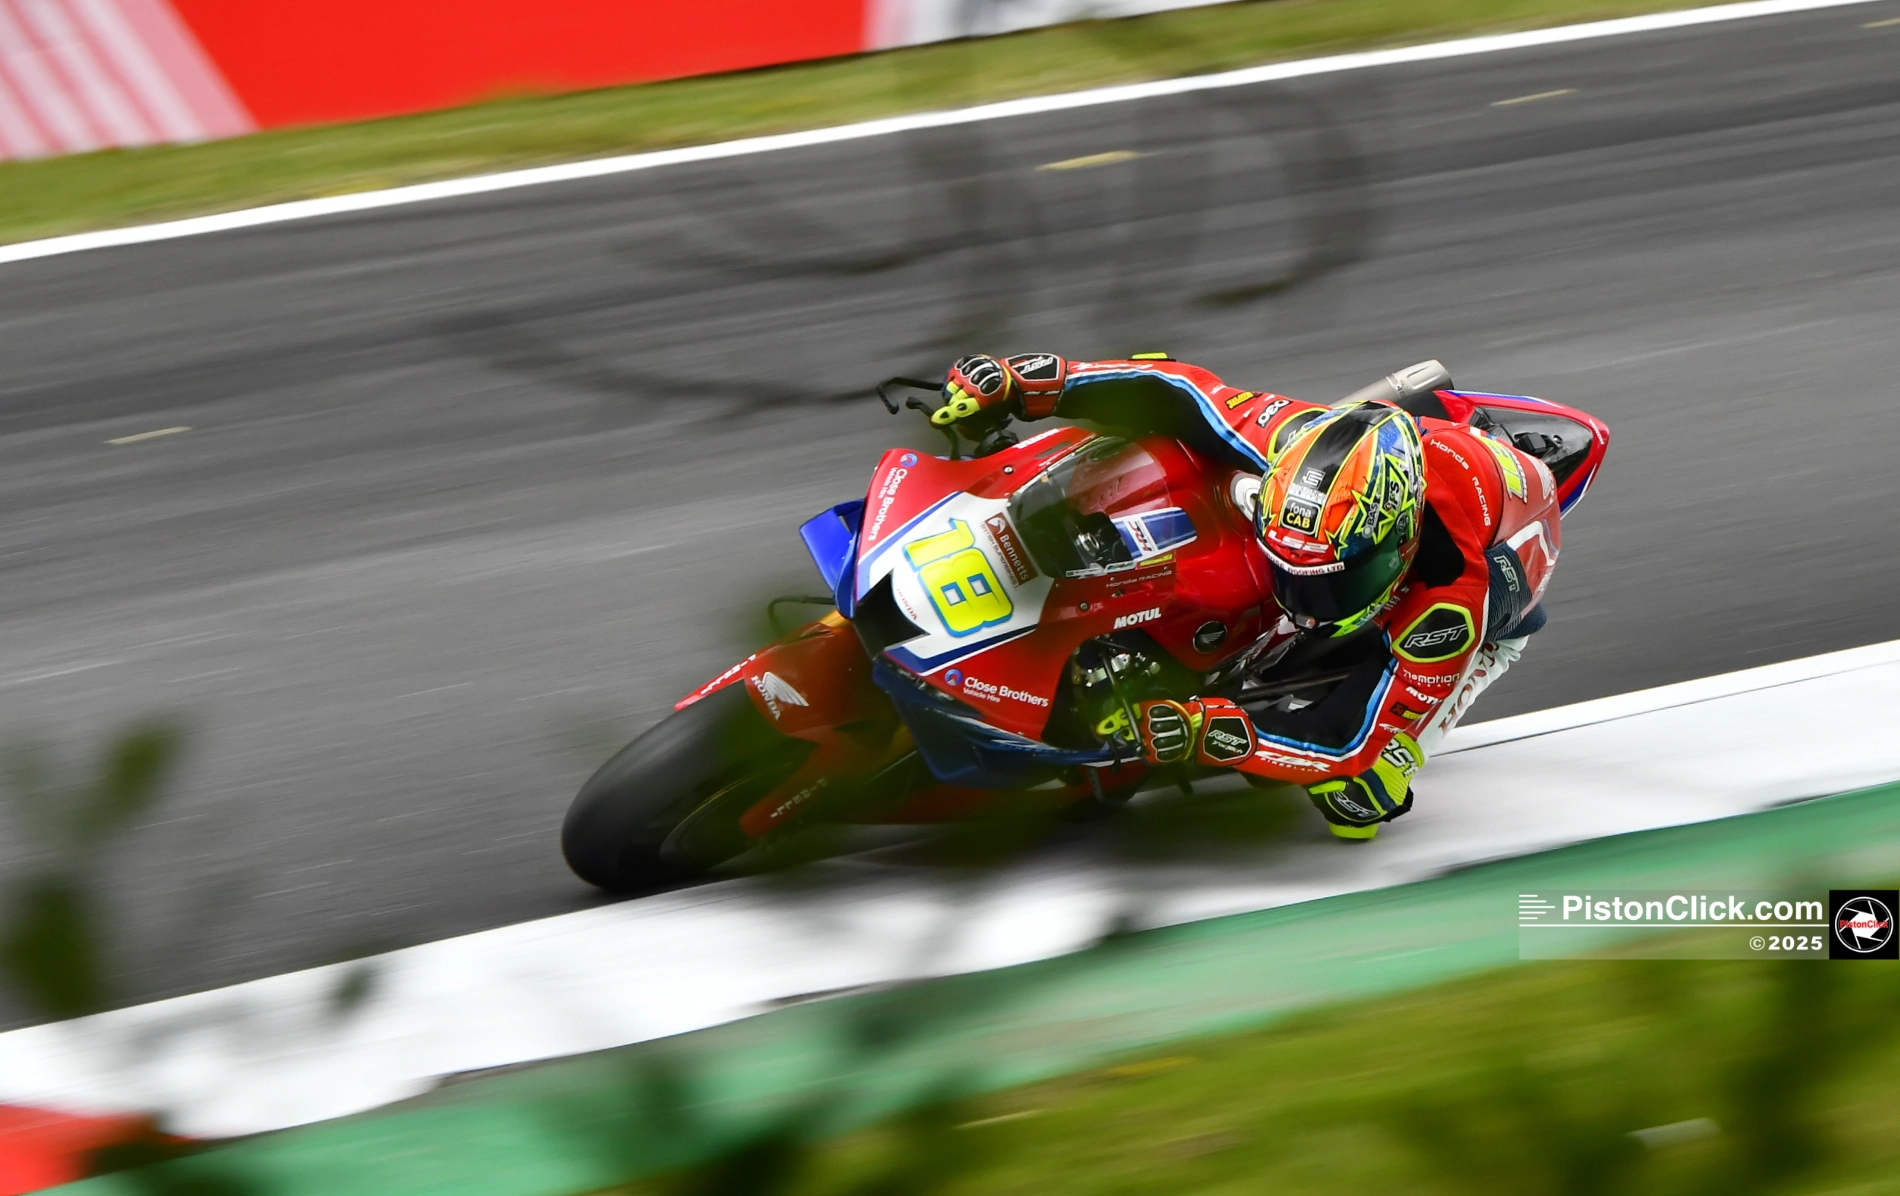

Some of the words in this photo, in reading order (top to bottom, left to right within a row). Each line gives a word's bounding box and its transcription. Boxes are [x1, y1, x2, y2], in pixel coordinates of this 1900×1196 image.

[886, 468, 908, 496] Close
[1430, 438, 1470, 471] Honda
[1471, 476, 1492, 527] RACING
[867, 496, 895, 541] Brothers
[1286, 512, 1311, 529] CAB
[1290, 502, 1312, 518] fona
[1000, 534, 1029, 580] Bennetts
[1267, 529, 1330, 554] LS2
[902, 517, 1014, 638] 18
[1493, 555, 1521, 593] RST
[1113, 607, 1162, 629] MOTUL
[1403, 624, 1468, 649] RST
[750, 675, 781, 720] HONDA
[964, 676, 998, 694] Close
[998, 685, 1050, 707] Brothers
[1438, 640, 1500, 738] HOND
[1208, 729, 1248, 746] RST
